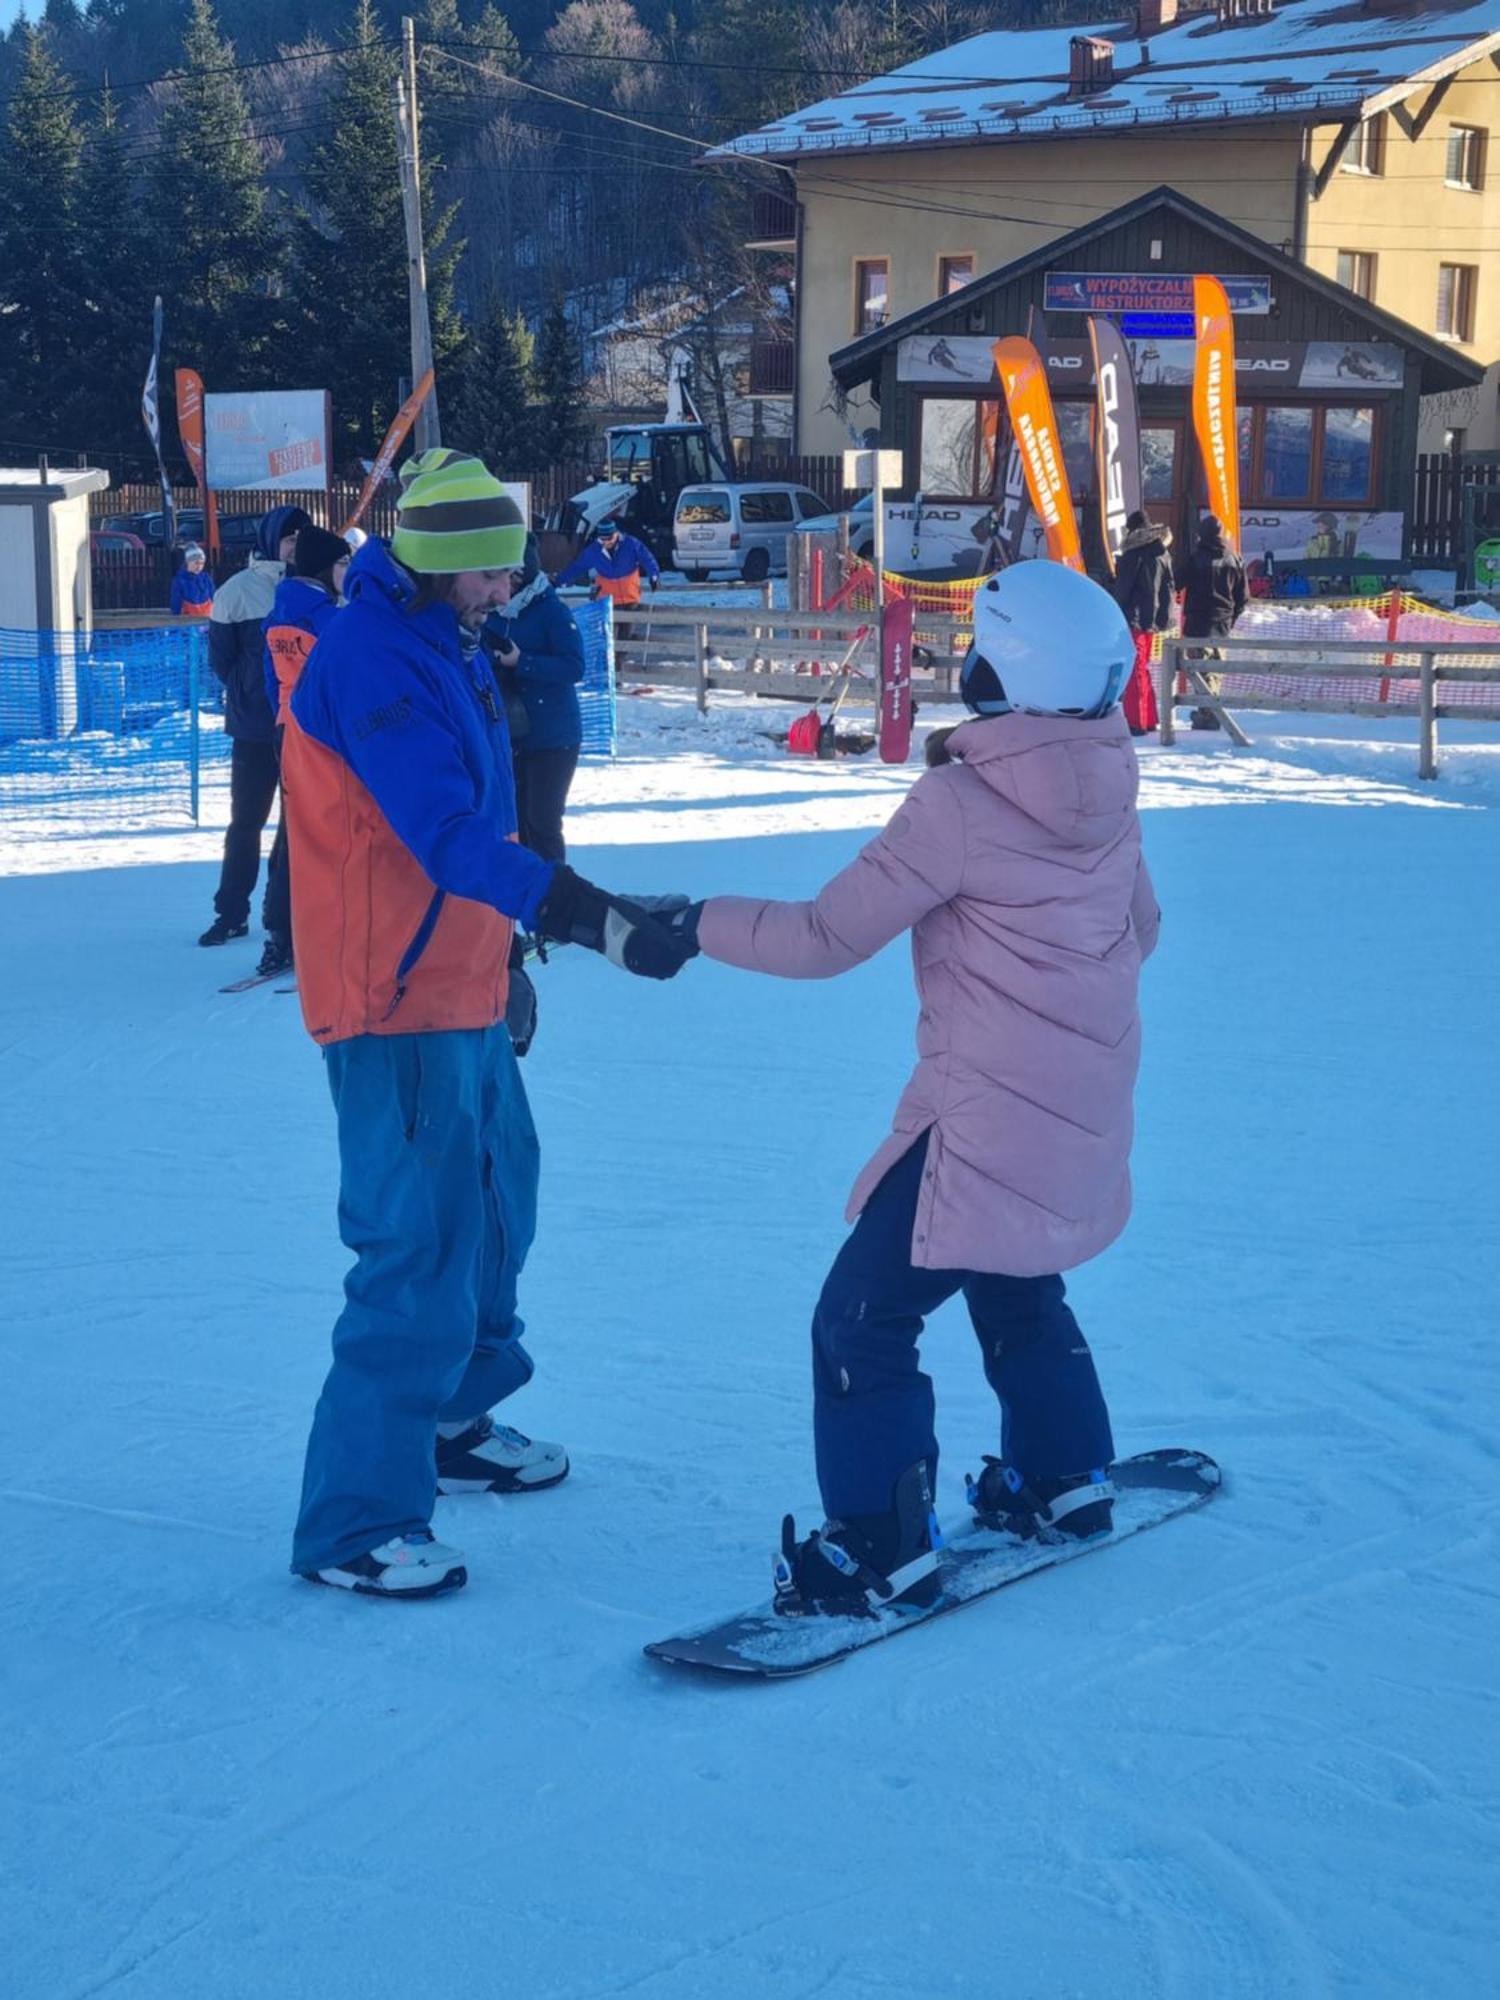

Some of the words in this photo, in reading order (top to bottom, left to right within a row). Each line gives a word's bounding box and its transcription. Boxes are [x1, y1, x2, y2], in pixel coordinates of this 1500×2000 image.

[1086, 277, 1194, 293] WYPOŻYCZALN
[1090, 295, 1194, 310] INSTRUKTORZ
[1048, 356, 1083, 369] AD
[1235, 359, 1290, 371] EAD
[888, 509, 961, 521] HEAD
[1241, 516, 1281, 528] AD
